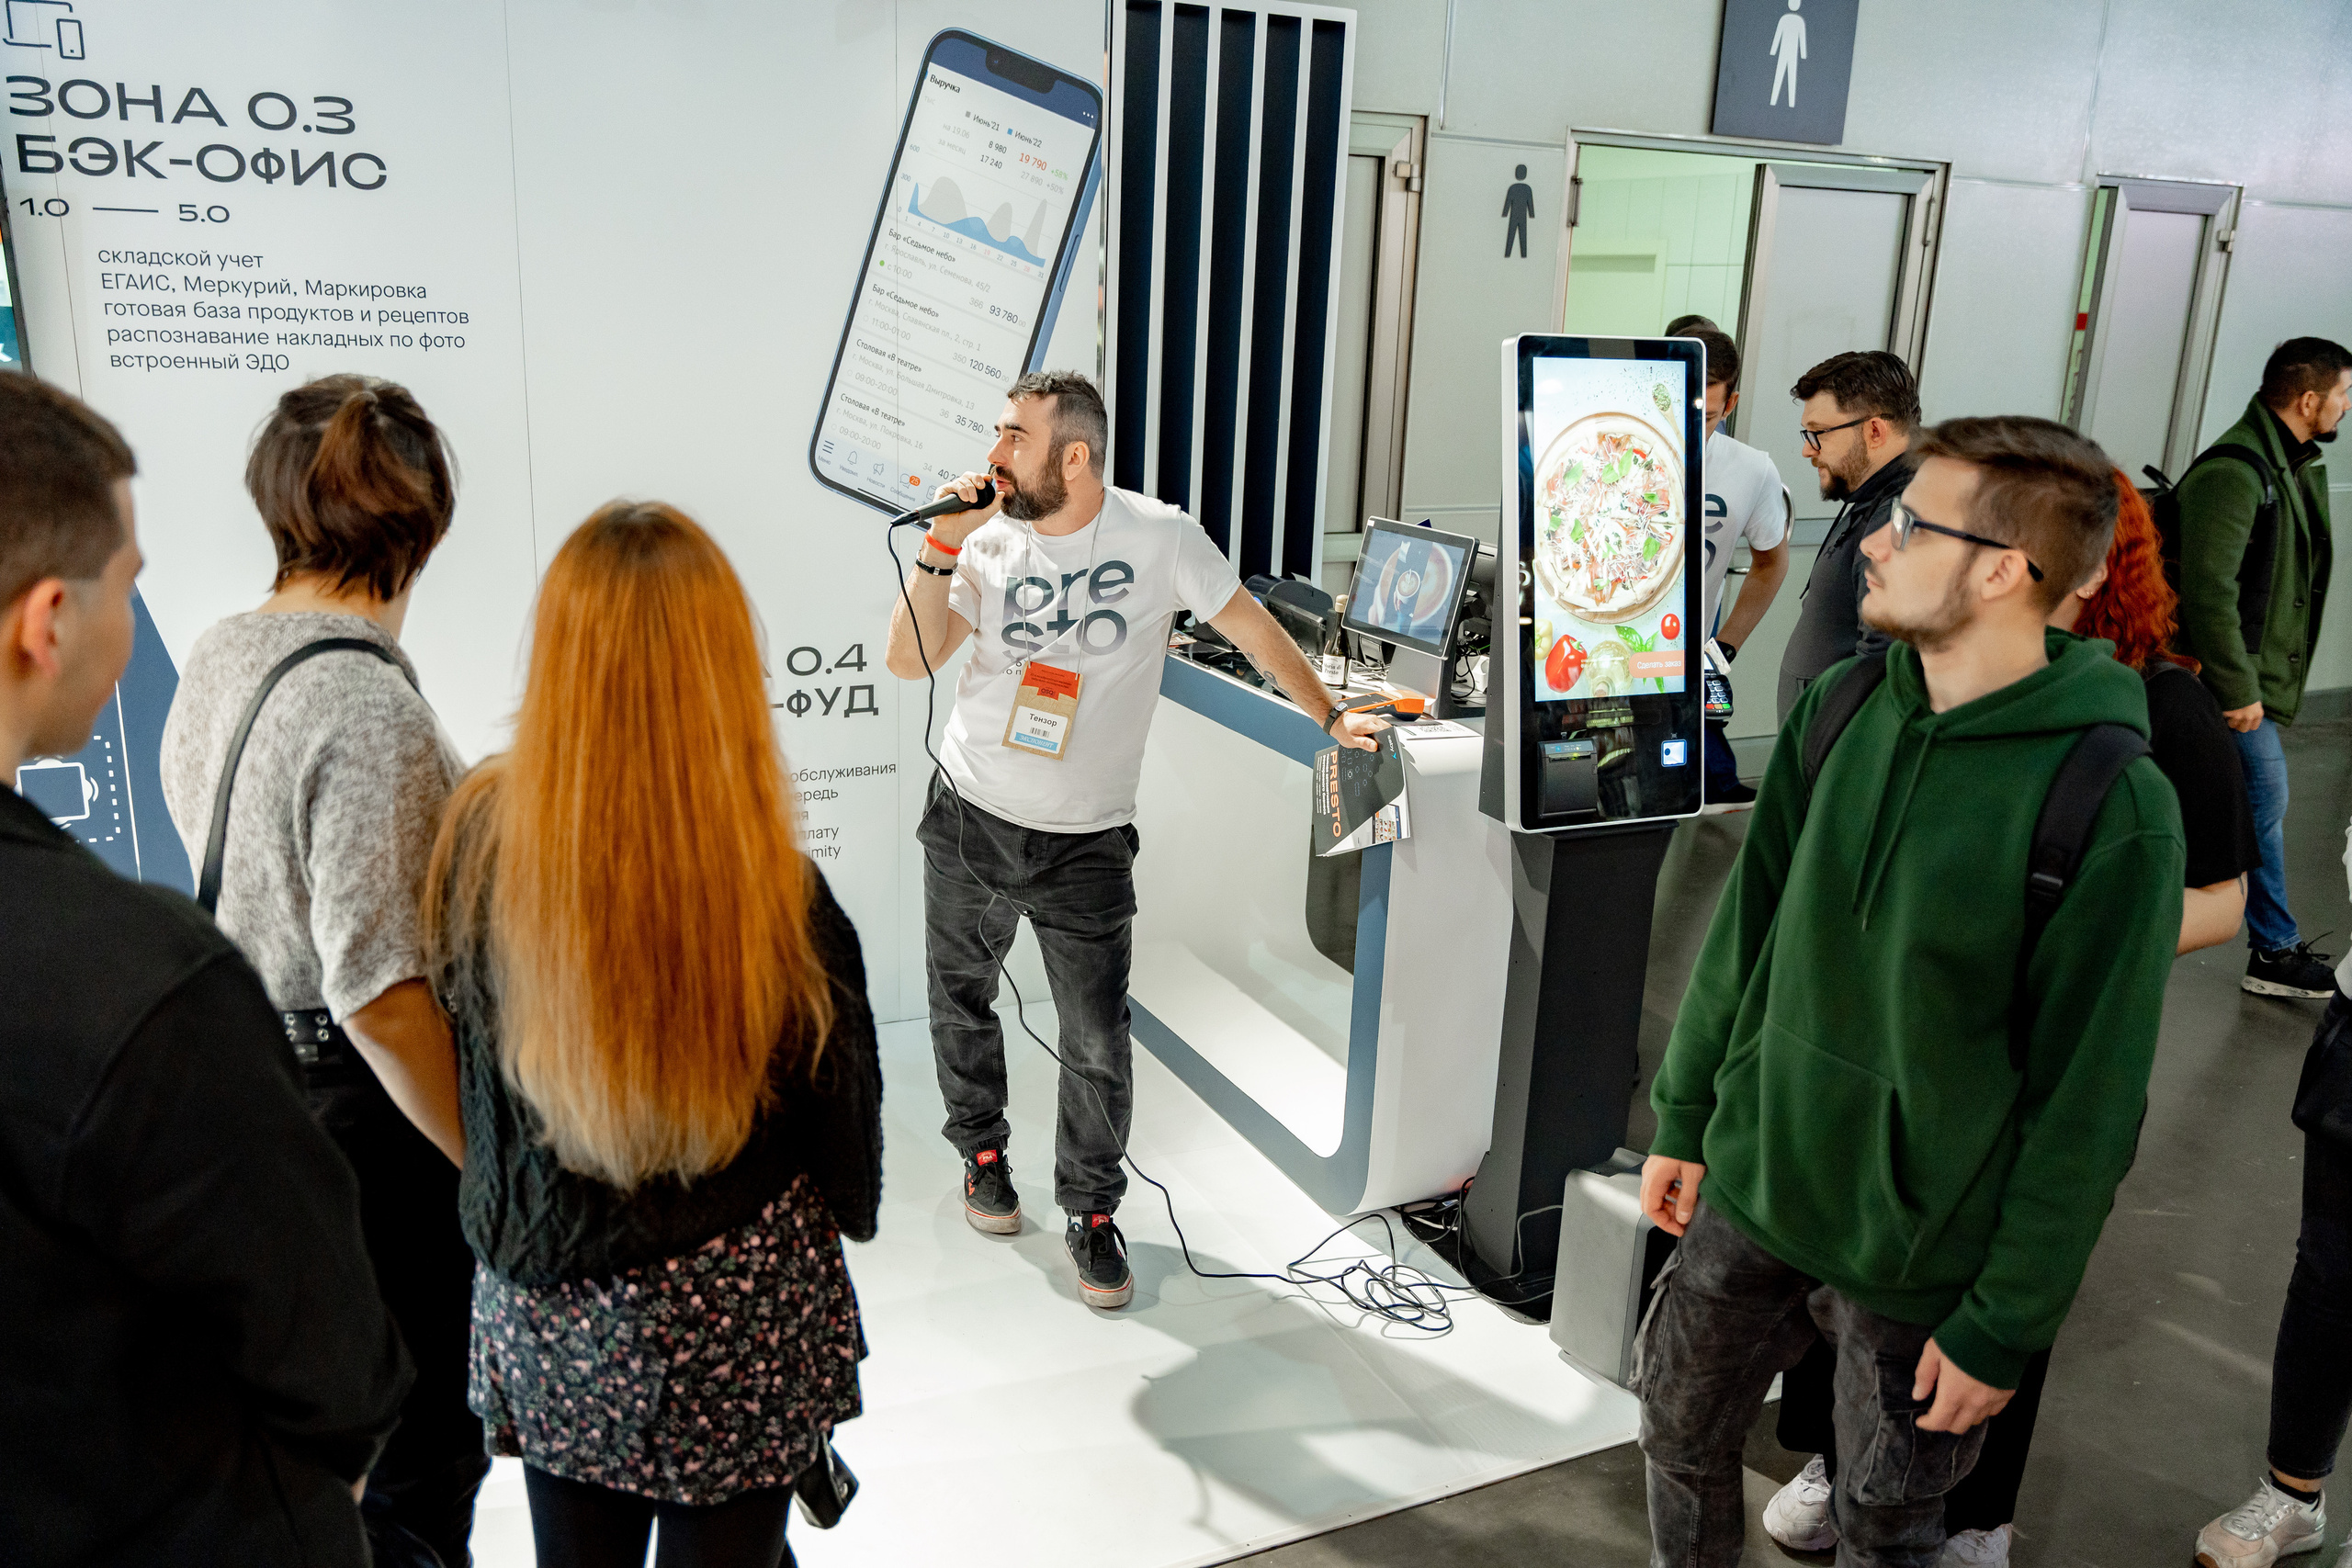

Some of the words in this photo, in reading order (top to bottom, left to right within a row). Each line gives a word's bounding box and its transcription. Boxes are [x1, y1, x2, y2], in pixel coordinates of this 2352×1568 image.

[928, 73, 962, 95] Выручка
[6, 74, 229, 128] ЗОНА
[942, 122, 951, 131] на
[951, 126, 970, 140] 19.06
[971, 113, 1001, 132] Июнь'21
[908, 143, 921, 153] 600
[937, 138, 946, 147] за
[945, 141, 967, 156] месяц
[987, 140, 994, 149] 8
[993, 142, 1007, 154] 980
[1013, 130, 1043, 149] Июнь'22
[15, 133, 388, 191] БЭК-ОФИС
[978, 153, 989, 164] 17
[989, 158, 1003, 170] 240
[1018, 152, 1031, 164] 19
[1030, 157, 1047, 172] 790
[899, 172, 911, 182] 300
[1020, 171, 1030, 181] 27
[1029, 175, 1044, 186] 890
[1049, 167, 1069, 181] +58%
[1045, 181, 1065, 196] +50%
[19, 197, 70, 218] 1.0
[178, 203, 231, 224] 5.0
[887, 227, 902, 242] Бар
[901, 233, 936, 255] «Седьмое
[934, 248, 956, 264] небо»
[943, 231, 950, 240] 10
[956, 237, 963, 245] 13
[983, 248, 990, 256] 19
[996, 254, 1003, 262] 22
[1036, 270, 1044, 278] 31
[98, 249, 211, 267] складской
[217, 254, 264, 272] учет
[883, 243, 889, 251] г.
[889, 244, 928, 267] Ярославль,
[927, 261, 938, 273] ул.
[938, 265, 975, 288] Семенова,
[974, 280, 990, 294] 45/2
[891, 265, 913, 279] 10:00
[101, 273, 176, 294] ЕГАИС,
[184, 276, 298, 299] Меркурий,
[305, 279, 427, 302] Маркировка
[871, 283, 886, 297] Бар
[885, 288, 919, 310] «Седьмое
[918, 302, 940, 319] небо»
[967, 297, 984, 310] 366
[104, 302, 187, 318] готовая
[193, 301, 241, 319] база
[248, 305, 355, 325] продуктов
[360, 310, 371, 321] и
[378, 310, 469, 327] рецептов
[988, 304, 1001, 317] 93
[1001, 309, 1019, 324] 780
[867, 298, 874, 306] г.
[874, 299, 902, 318] Москва,
[901, 311, 941, 334] Славянская
[940, 329, 954, 341] пл.,
[953, 333, 962, 344] 2,
[961, 338, 976, 350] стр.
[976, 343, 981, 352] 1
[870, 317, 911, 341] 11:00-01:00
[107, 328, 269, 346] распознавание
[277, 332, 384, 349] накладных
[390, 334, 413, 348] по
[419, 333, 466, 352] фото
[110, 353, 240, 373] встроенный
[245, 353, 289, 374] ЭДО
[854, 337, 888, 358] Столовая
[886, 351, 897, 362] «В
[895, 356, 922, 375] театре»
[951, 351, 967, 365] 350
[967, 357, 984, 372] 120
[983, 364, 1002, 379] 560
[851, 353, 858, 361] г.
[857, 355, 886, 373] Москва,
[884, 367, 895, 378] ул.
[896, 371, 925, 389] Большая
[924, 383, 966, 408] Дмитровка,
[964, 400, 975, 411] 13
[854, 371, 899, 397] 09:00-20:00
[839, 391, 871, 412] Столовая
[870, 405, 880, 416] «В
[879, 411, 906, 428] театре»
[938, 407, 950, 419] 36
[842, 408, 870, 427] Москва,
[868, 421, 879, 432] ул.
[878, 424, 915, 446] Покровка,
[954, 413, 967, 427] 35
[966, 419, 984, 434] 780
[838, 424, 882, 450] 09:00-20:00
[922, 461, 933, 472] 34
[936, 468, 950, 480] 40
[1001, 559, 1135, 626] pre
[1001, 609, 1128, 660] sto
[1636, 660, 1664, 671] Сделать
[1664, 659, 1682, 668] заказ
[771, 683, 879, 718] -ФУД
[1029, 713, 1057, 727] Тензор
[1019, 735, 1055, 749] ЭКСПОНЕНТ
[790, 763, 897, 784] обслуживания
[793, 788, 839, 805] ередь
[1329, 750, 1342, 838] PRESTO
[798, 827, 840, 840] плату
